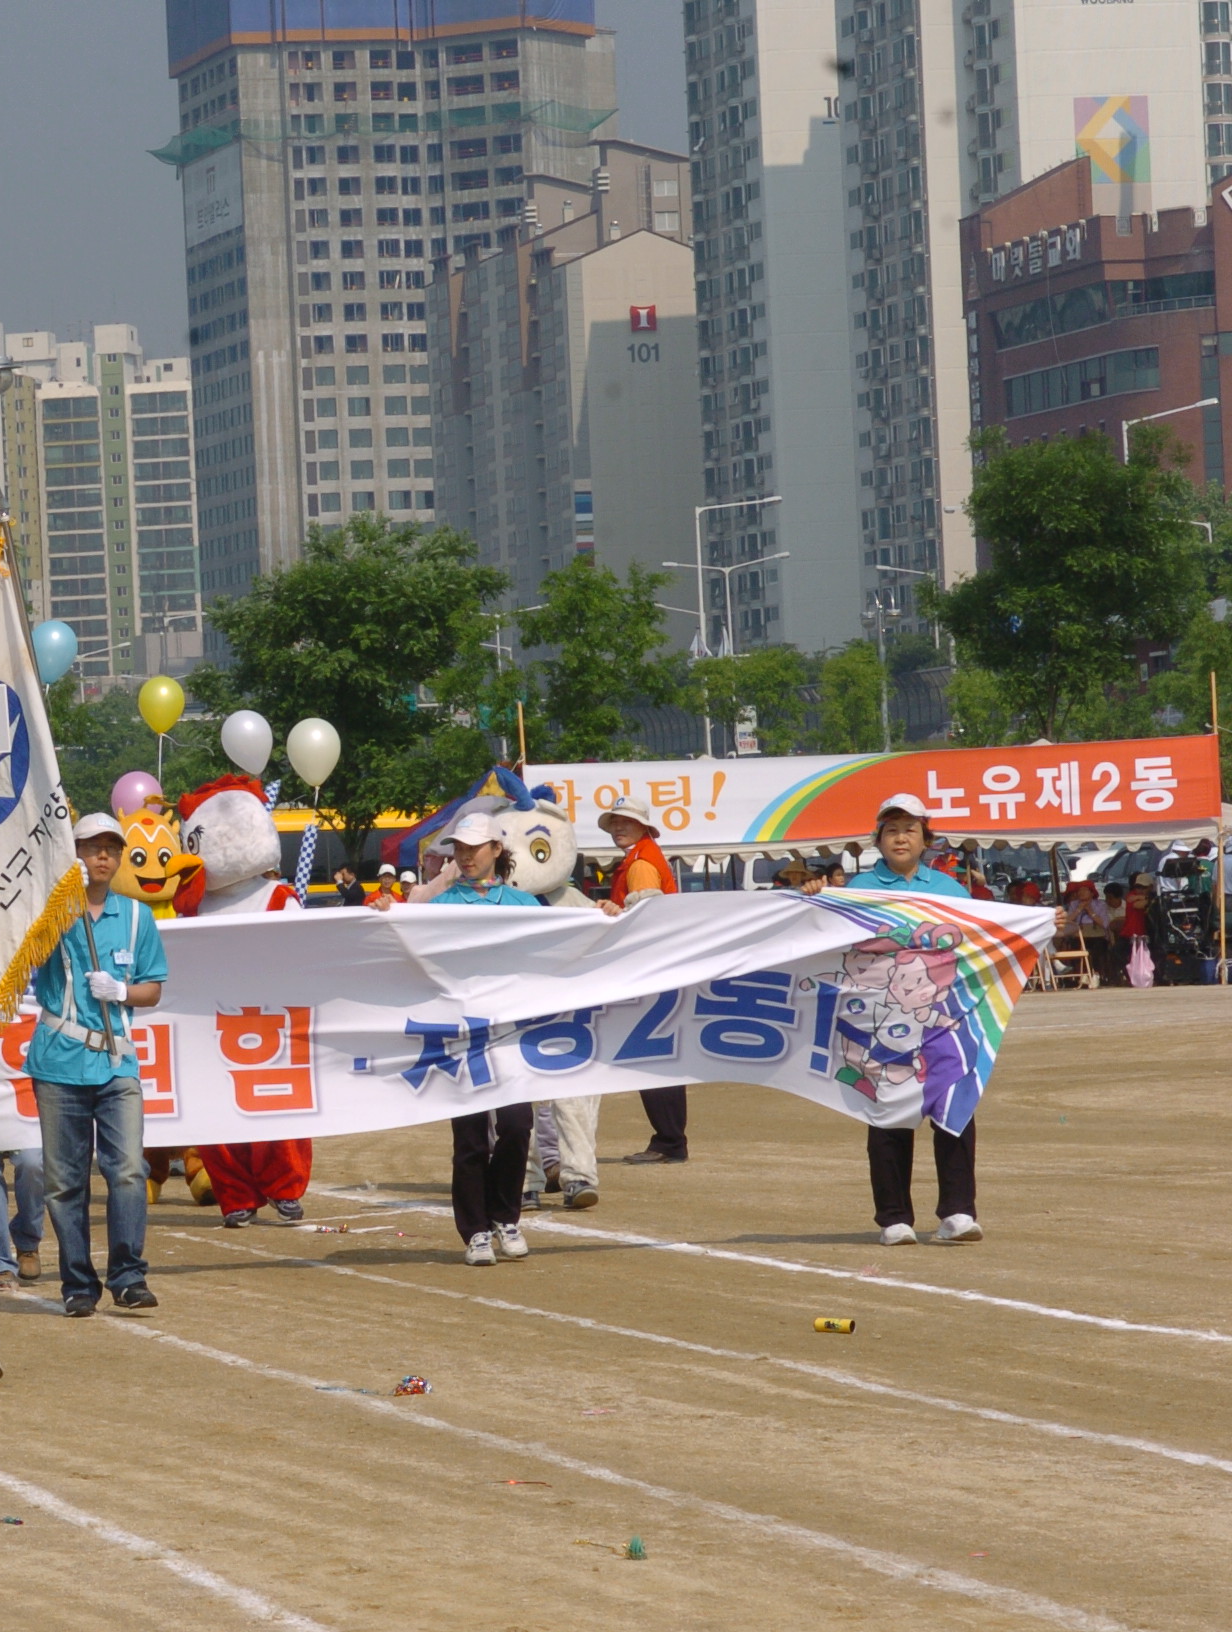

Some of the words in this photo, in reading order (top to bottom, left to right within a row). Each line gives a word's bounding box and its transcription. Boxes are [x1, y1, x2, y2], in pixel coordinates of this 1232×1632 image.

[992, 227, 1082, 282] 머릿돌교회
[627, 342, 660, 363] 101
[216, 1005, 314, 1112] 힘
